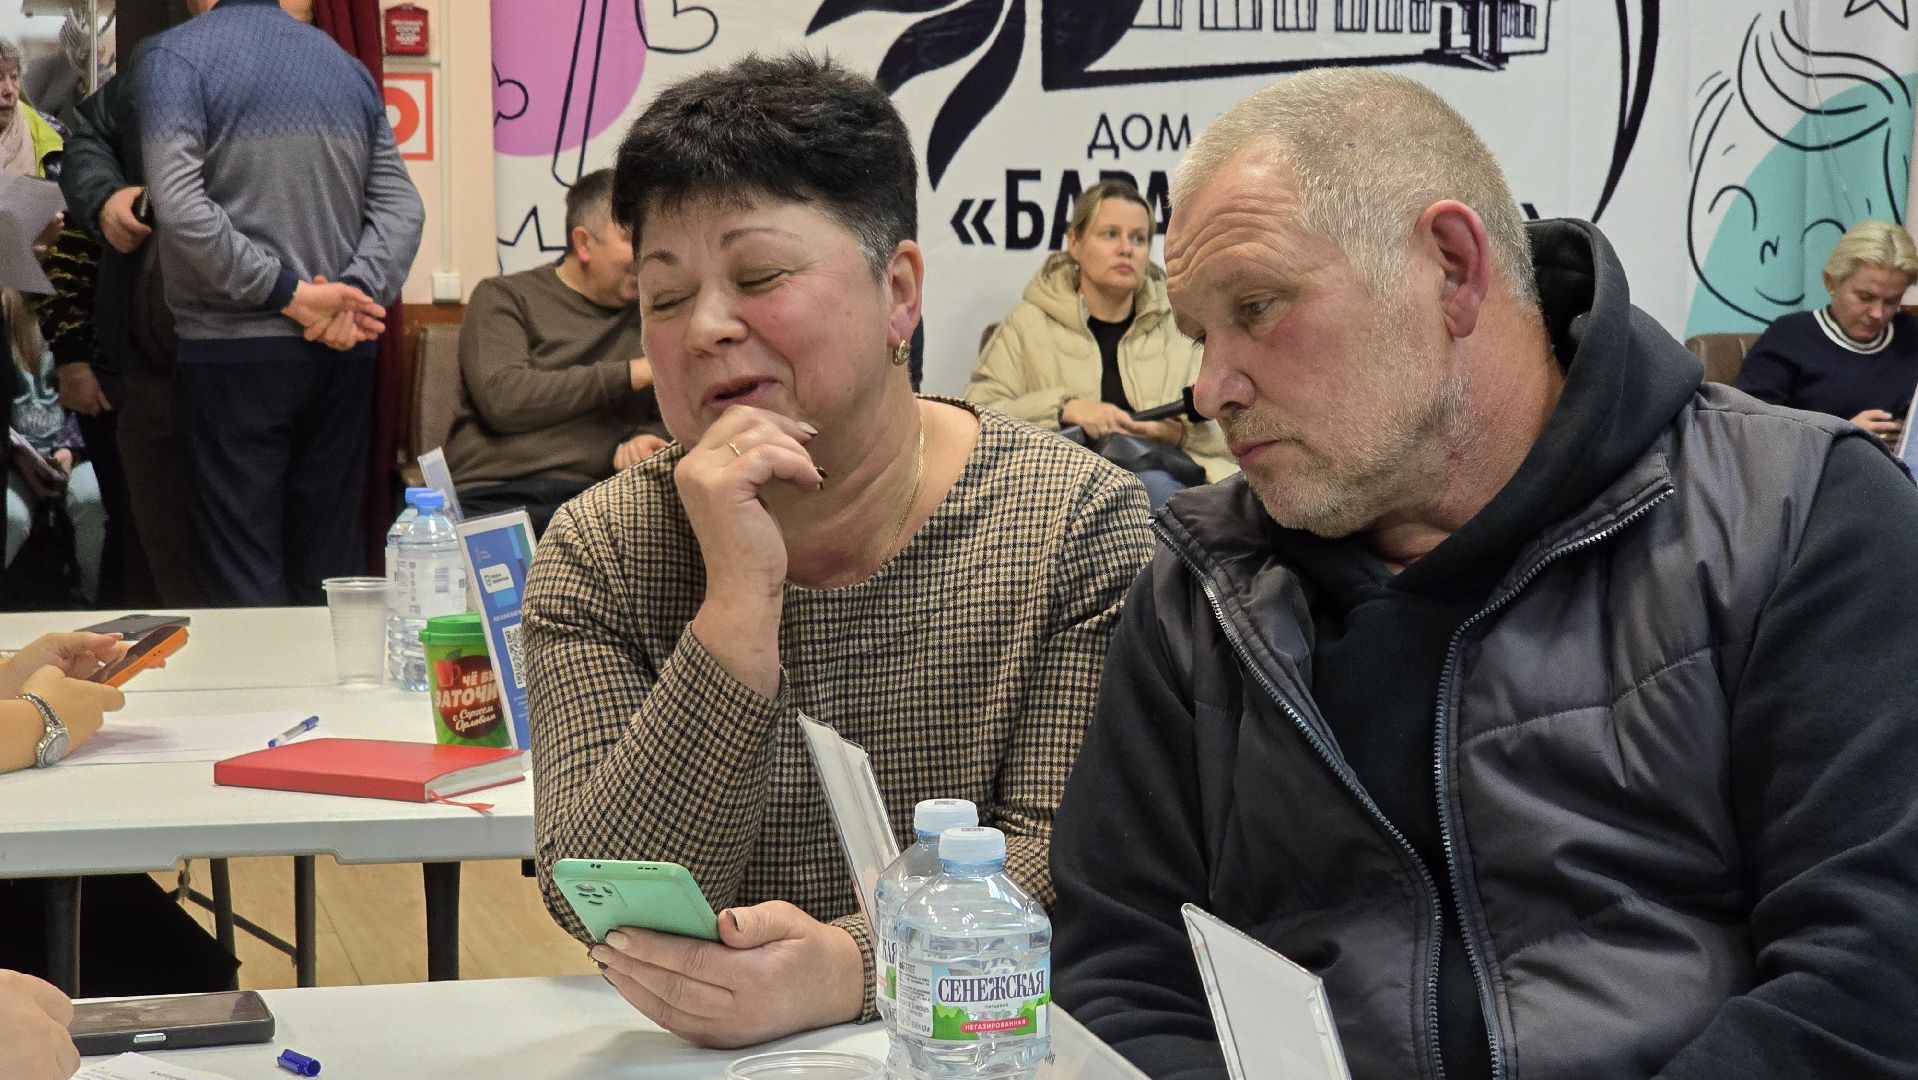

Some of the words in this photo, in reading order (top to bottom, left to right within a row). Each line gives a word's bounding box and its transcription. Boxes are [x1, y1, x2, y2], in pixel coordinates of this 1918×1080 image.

[1087, 112, 1192, 159] ДОМ
[462, 670, 478, 687] ЧЁ
[455, 713, 497, 732] Орловым
[938, 970, 1045, 1003] СЕНЕЖСКАЯ
[965, 1018, 1027, 1031] НЕГАЗИРОВАННАЯ
